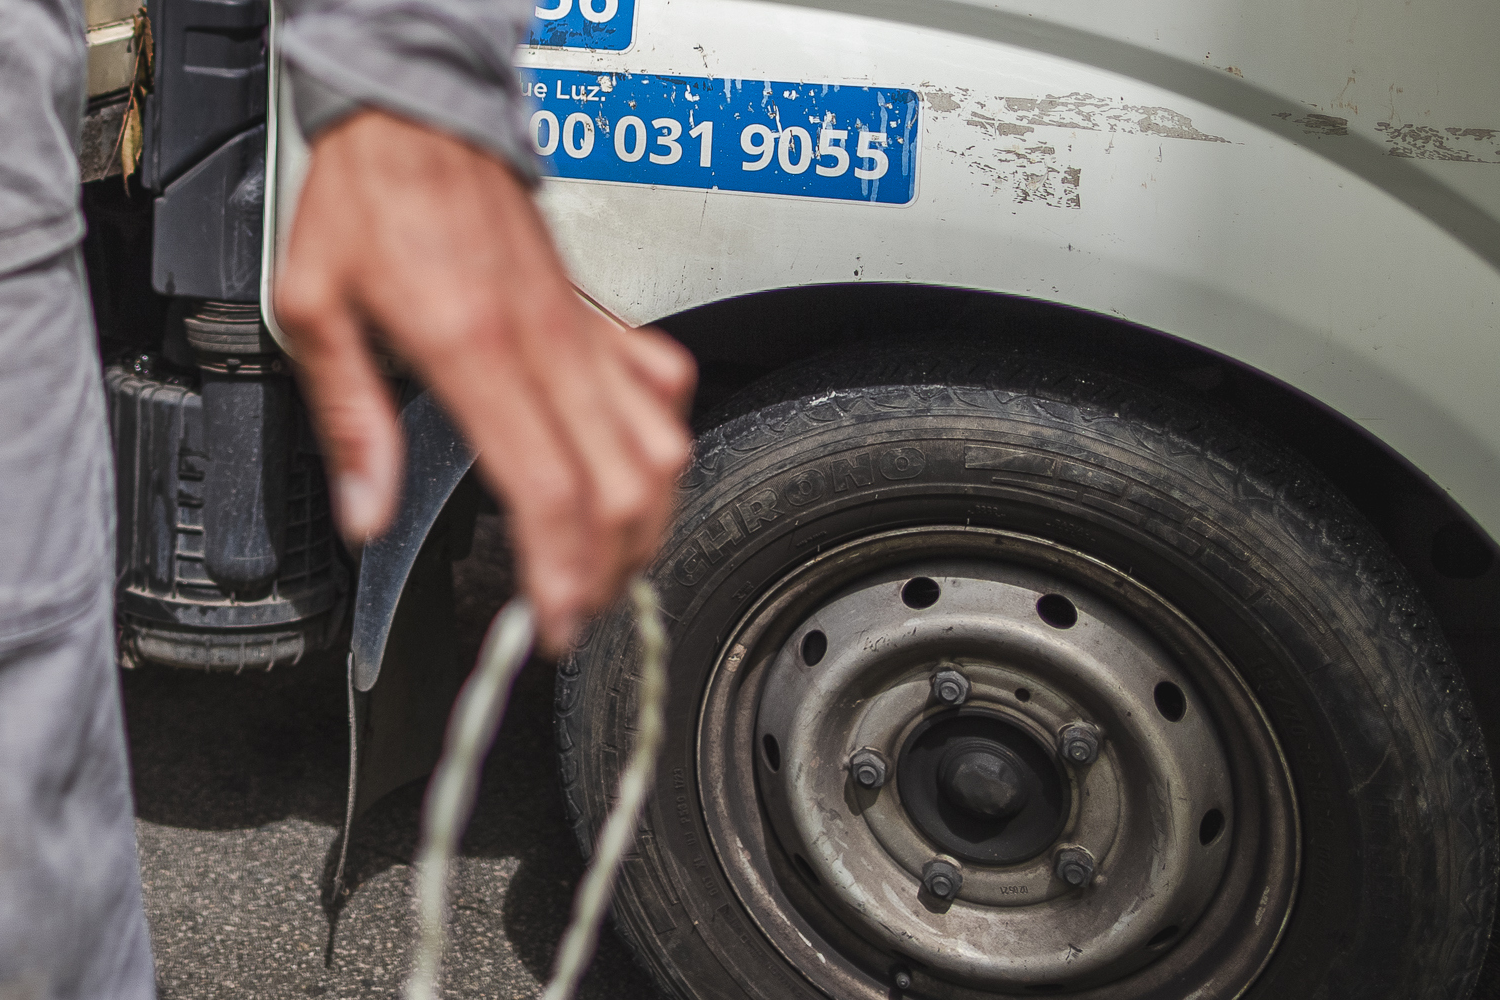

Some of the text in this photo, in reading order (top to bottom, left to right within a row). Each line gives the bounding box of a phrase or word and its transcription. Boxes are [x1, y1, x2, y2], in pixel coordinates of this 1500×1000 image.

[529, 109, 890, 181] 00 031 9055
[672, 446, 927, 587] CHRONO
